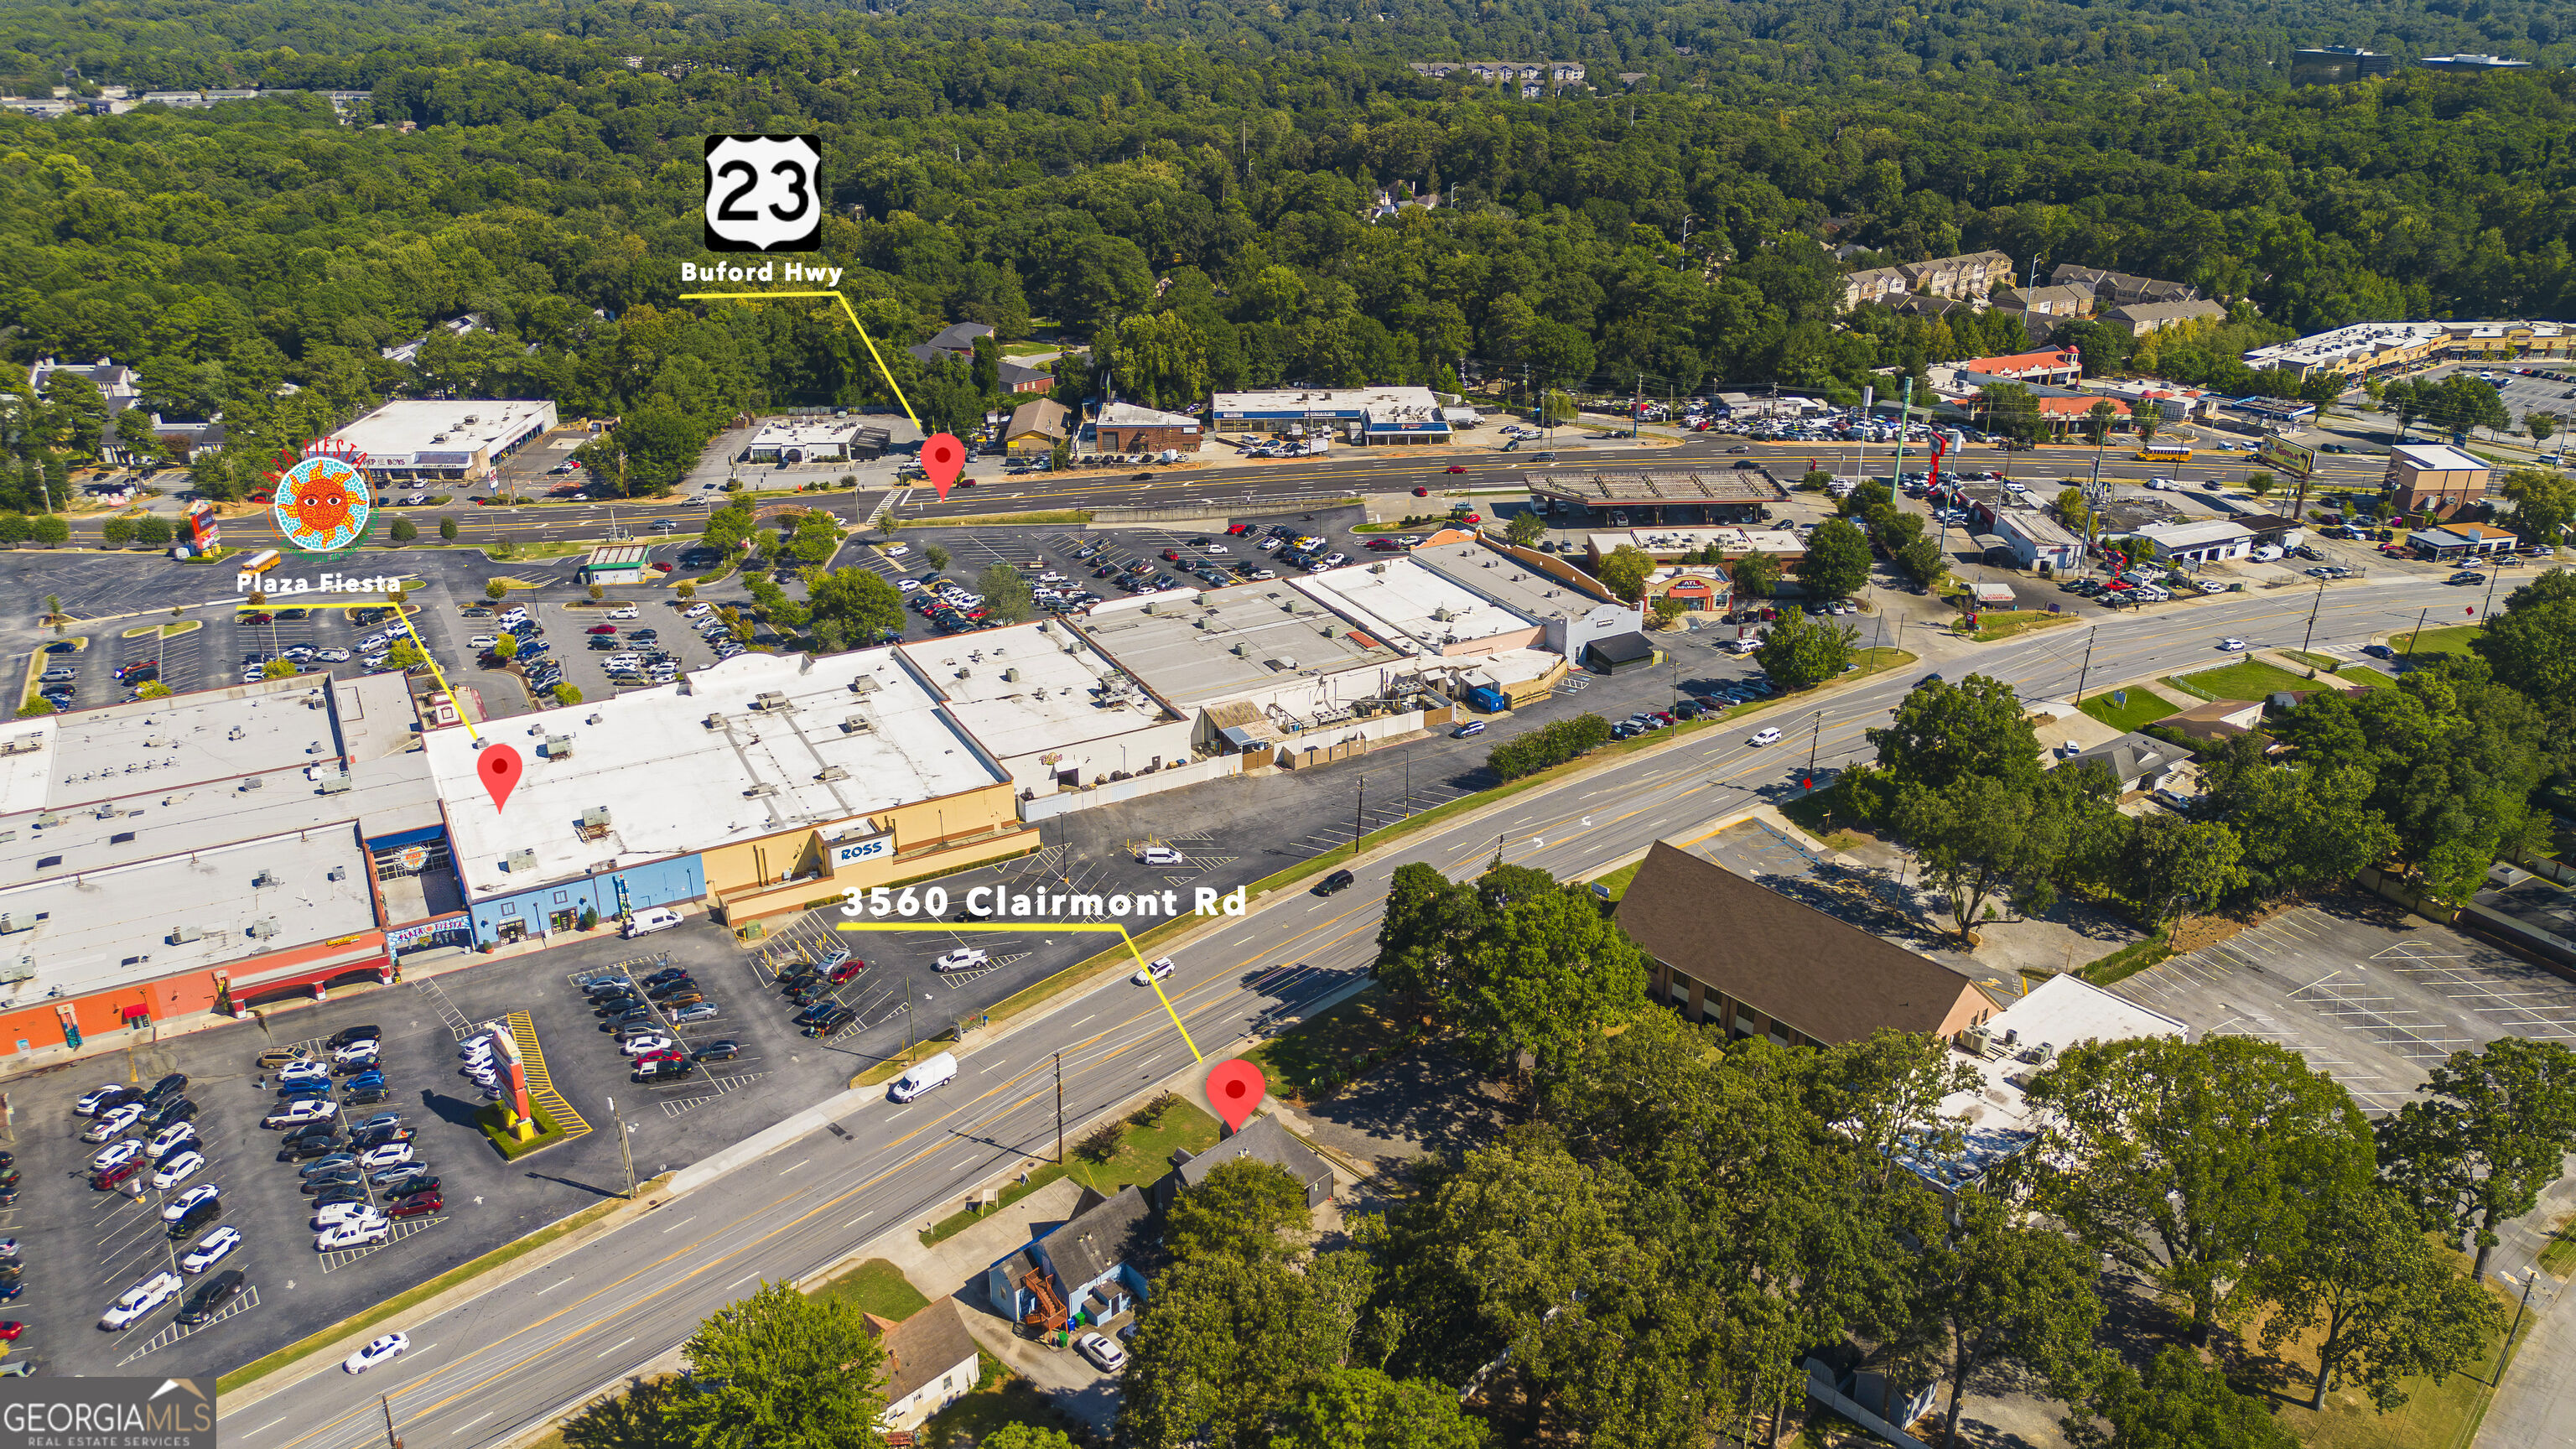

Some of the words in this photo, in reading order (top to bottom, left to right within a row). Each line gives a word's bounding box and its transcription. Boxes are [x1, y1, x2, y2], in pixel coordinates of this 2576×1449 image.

[387, 458, 406, 466] BOYS
[841, 841, 883, 860] ROSS
[398, 927, 424, 941] PLAZA
[434, 921, 463, 931] FIESTA
